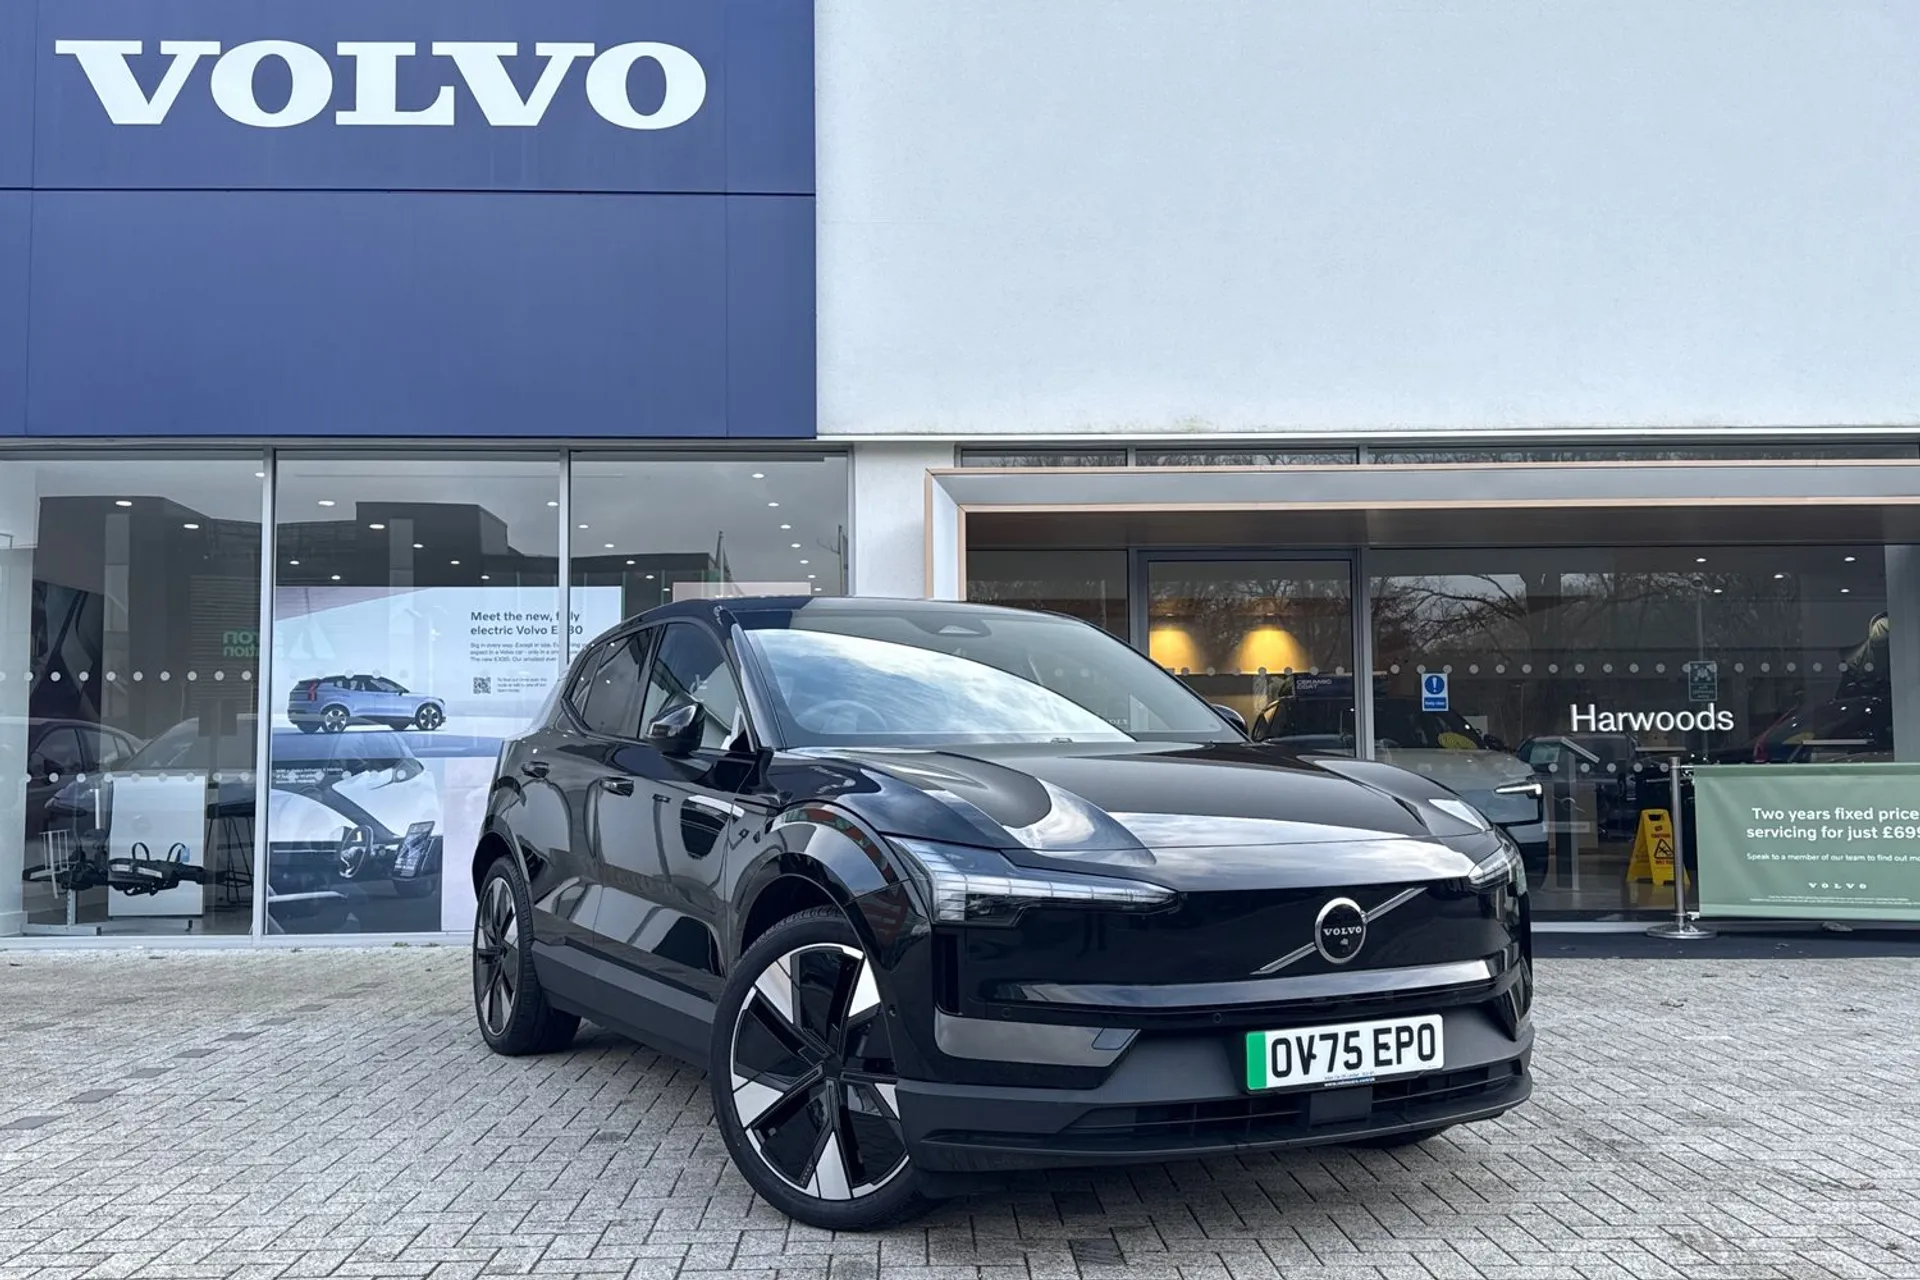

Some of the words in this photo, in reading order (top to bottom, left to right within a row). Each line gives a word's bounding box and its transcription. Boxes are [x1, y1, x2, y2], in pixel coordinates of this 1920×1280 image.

[55, 40, 707, 130] VOLVO
[471, 611, 501, 621] Meet
[504, 611, 523, 621] the
[525, 612, 553, 623] new,
[556, 611, 580, 622] fly
[470, 625, 514, 635] electric
[516, 625, 548, 635] Volvo
[551, 625, 584, 635] E30
[1570, 702, 1735, 732] Harwoods
[1751, 807, 1785, 820] Two
[1788, 810, 1831, 823] years
[1834, 807, 1874, 820] fixed
[1878, 807, 1920, 823] price
[1746, 825, 1817, 841] servicing
[1821, 825, 1844, 839] for
[1847, 825, 1878, 841] just
[1746, 853, 1770, 861] Speak
[1877, 854, 1892, 862] find
[1808, 882, 1867, 890] VOLVO
[1323, 926, 1362, 936] VOLVO
[1271, 1031, 1363, 1078] OV75
[1373, 1023, 1436, 1067] EPO
